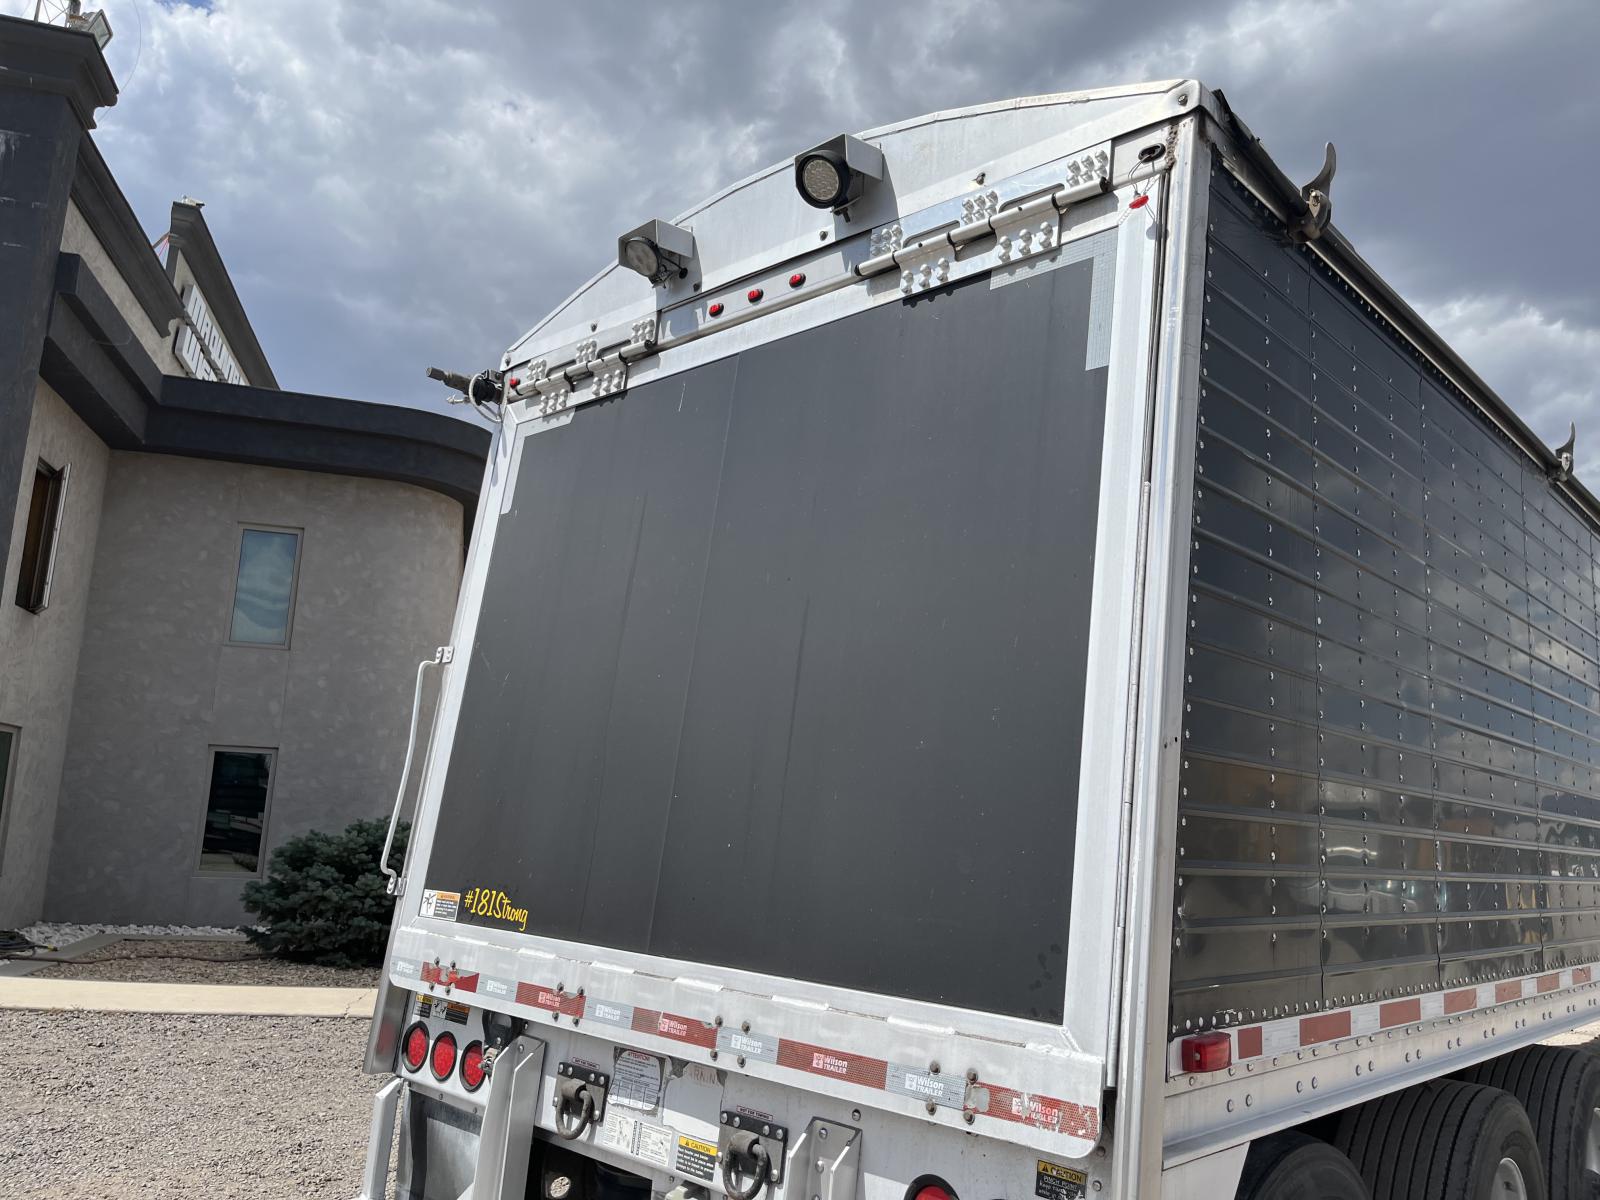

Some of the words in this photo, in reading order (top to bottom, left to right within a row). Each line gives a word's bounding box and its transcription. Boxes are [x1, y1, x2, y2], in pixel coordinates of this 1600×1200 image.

[185, 284, 246, 385] MAQUINA
[464, 888, 529, 931] #181Strong
[604, 1005, 621, 1015] Wilson
[669, 1020, 687, 1031] Wilson
[741, 1035, 762, 1048] Wilson
[824, 1055, 848, 1067] Wilson
[823, 1063, 847, 1074] TRAILER
[917, 1075, 944, 1090] Wilson
[917, 1085, 943, 1097] TRAILER
[1030, 1101, 1058, 1116] Wilson
[690, 1142, 711, 1153] CAUTION
[1050, 1166, 1082, 1182] CAUTION
